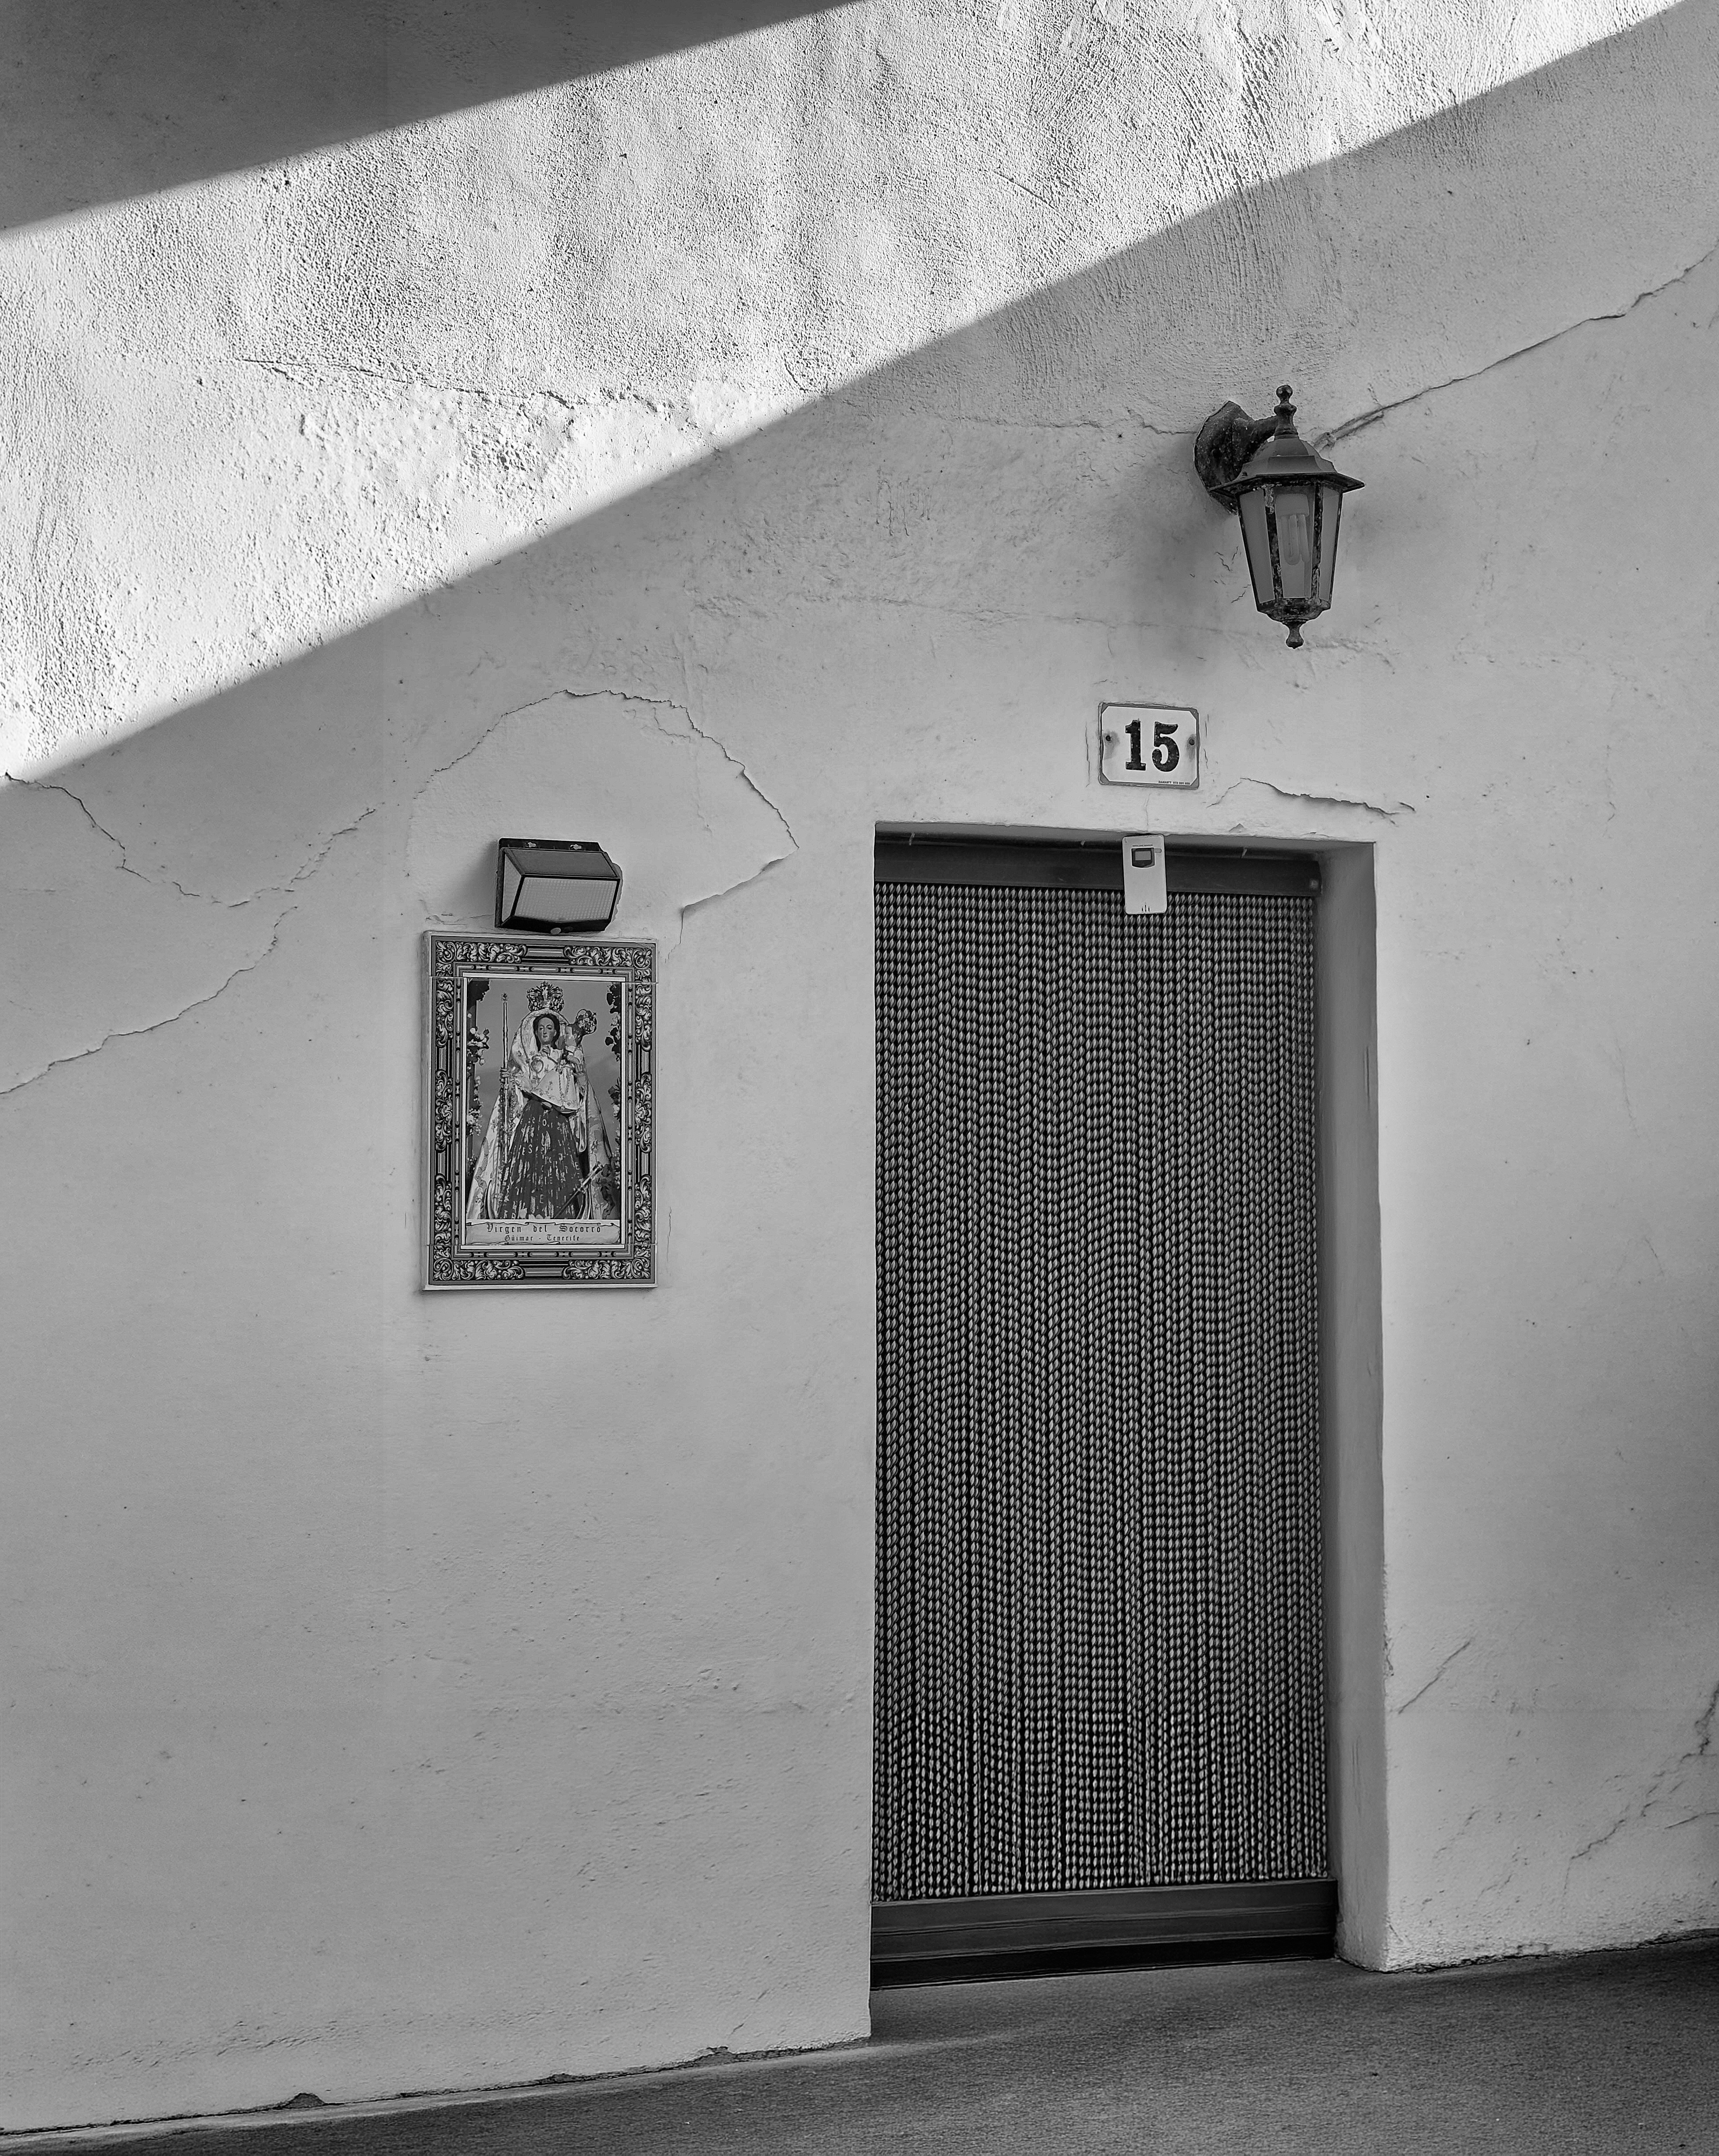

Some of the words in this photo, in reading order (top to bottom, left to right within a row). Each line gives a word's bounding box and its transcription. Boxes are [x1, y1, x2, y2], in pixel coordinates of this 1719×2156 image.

[1125, 720, 1179, 772] 15
[487, 1223, 522, 1234] Virgen
[559, 1224, 601, 1233] Socorro
